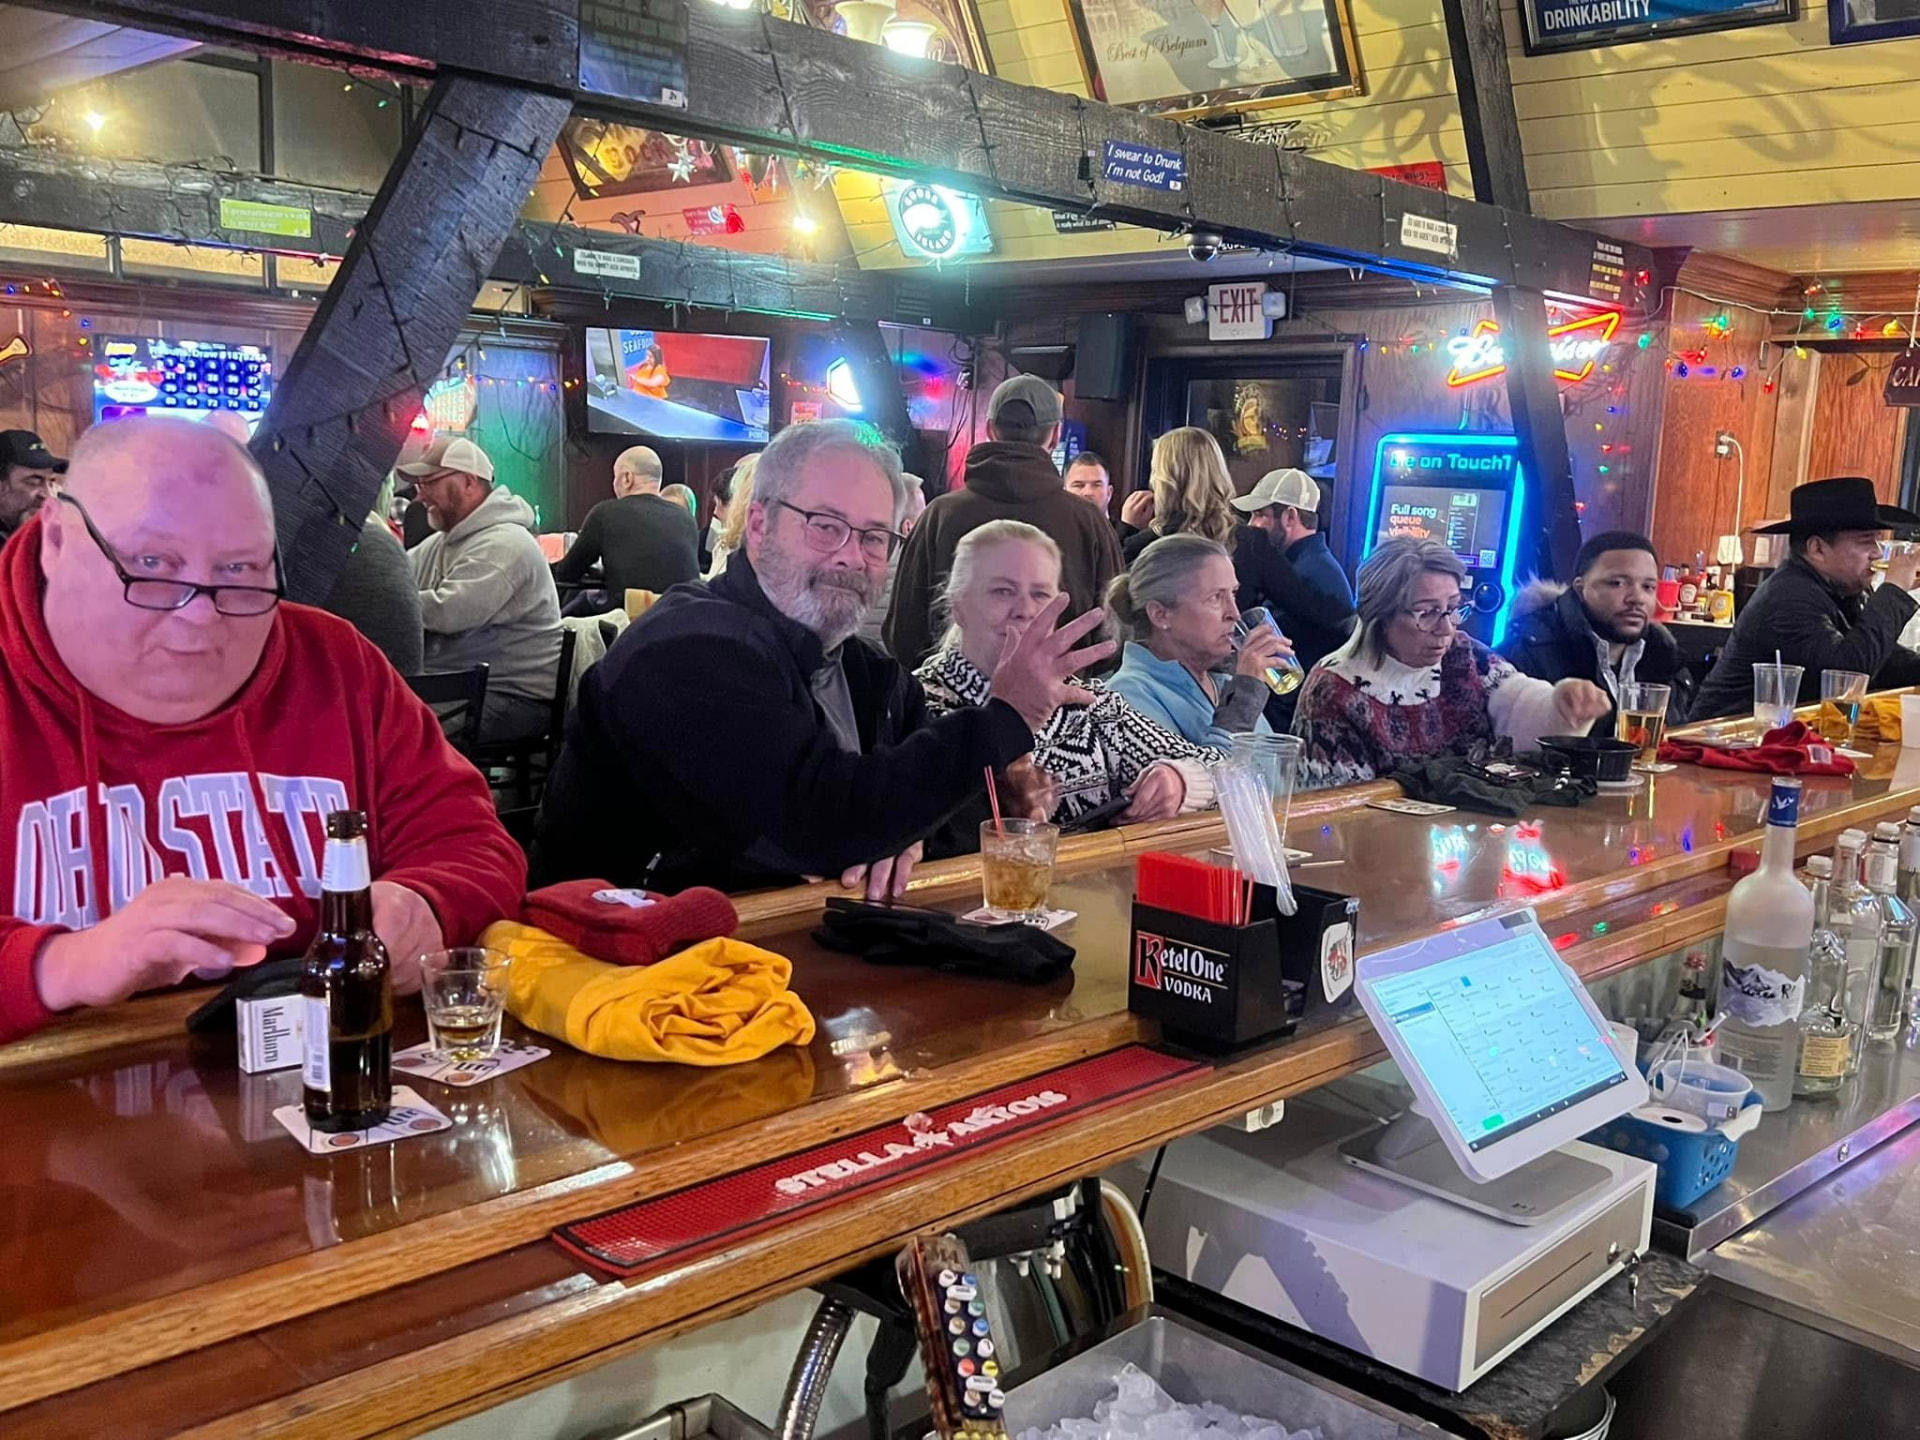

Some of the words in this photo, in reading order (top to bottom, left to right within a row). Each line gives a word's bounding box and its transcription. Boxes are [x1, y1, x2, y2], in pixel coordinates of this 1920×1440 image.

[1543, 0, 1650, 30] DRINKABILITY
[1106, 41, 1137, 61] Best
[1140, 41, 1151, 62] of
[1152, 33, 1208, 58] Belgium
[1108, 144, 1114, 156] I
[1114, 148, 1142, 162] swear
[1143, 152, 1153, 165] to
[1155, 153, 1182, 170] Drunk
[1106, 162, 1124, 176] I'm
[1125, 168, 1142, 180] not
[1143, 169, 1166, 184] God!
[903, 187, 939, 207] GOOSE
[916, 229, 952, 250] ISLAND
[1219, 287, 1257, 324] EXIT
[1419, 456, 1442, 469] on
[1389, 515, 1422, 525] queue
[1390, 504, 1410, 515] Full
[1411, 507, 1437, 519] song
[1388, 526, 1431, 539] visibility
[1136, 935, 1188, 990] Ketel
[1190, 950, 1224, 982] One
[1164, 976, 1212, 1004] VODKA
[262, 1006, 291, 1063] Marlboro
[775, 1140, 922, 1194] STELLA
[947, 1090, 1068, 1137] ARTOIS
